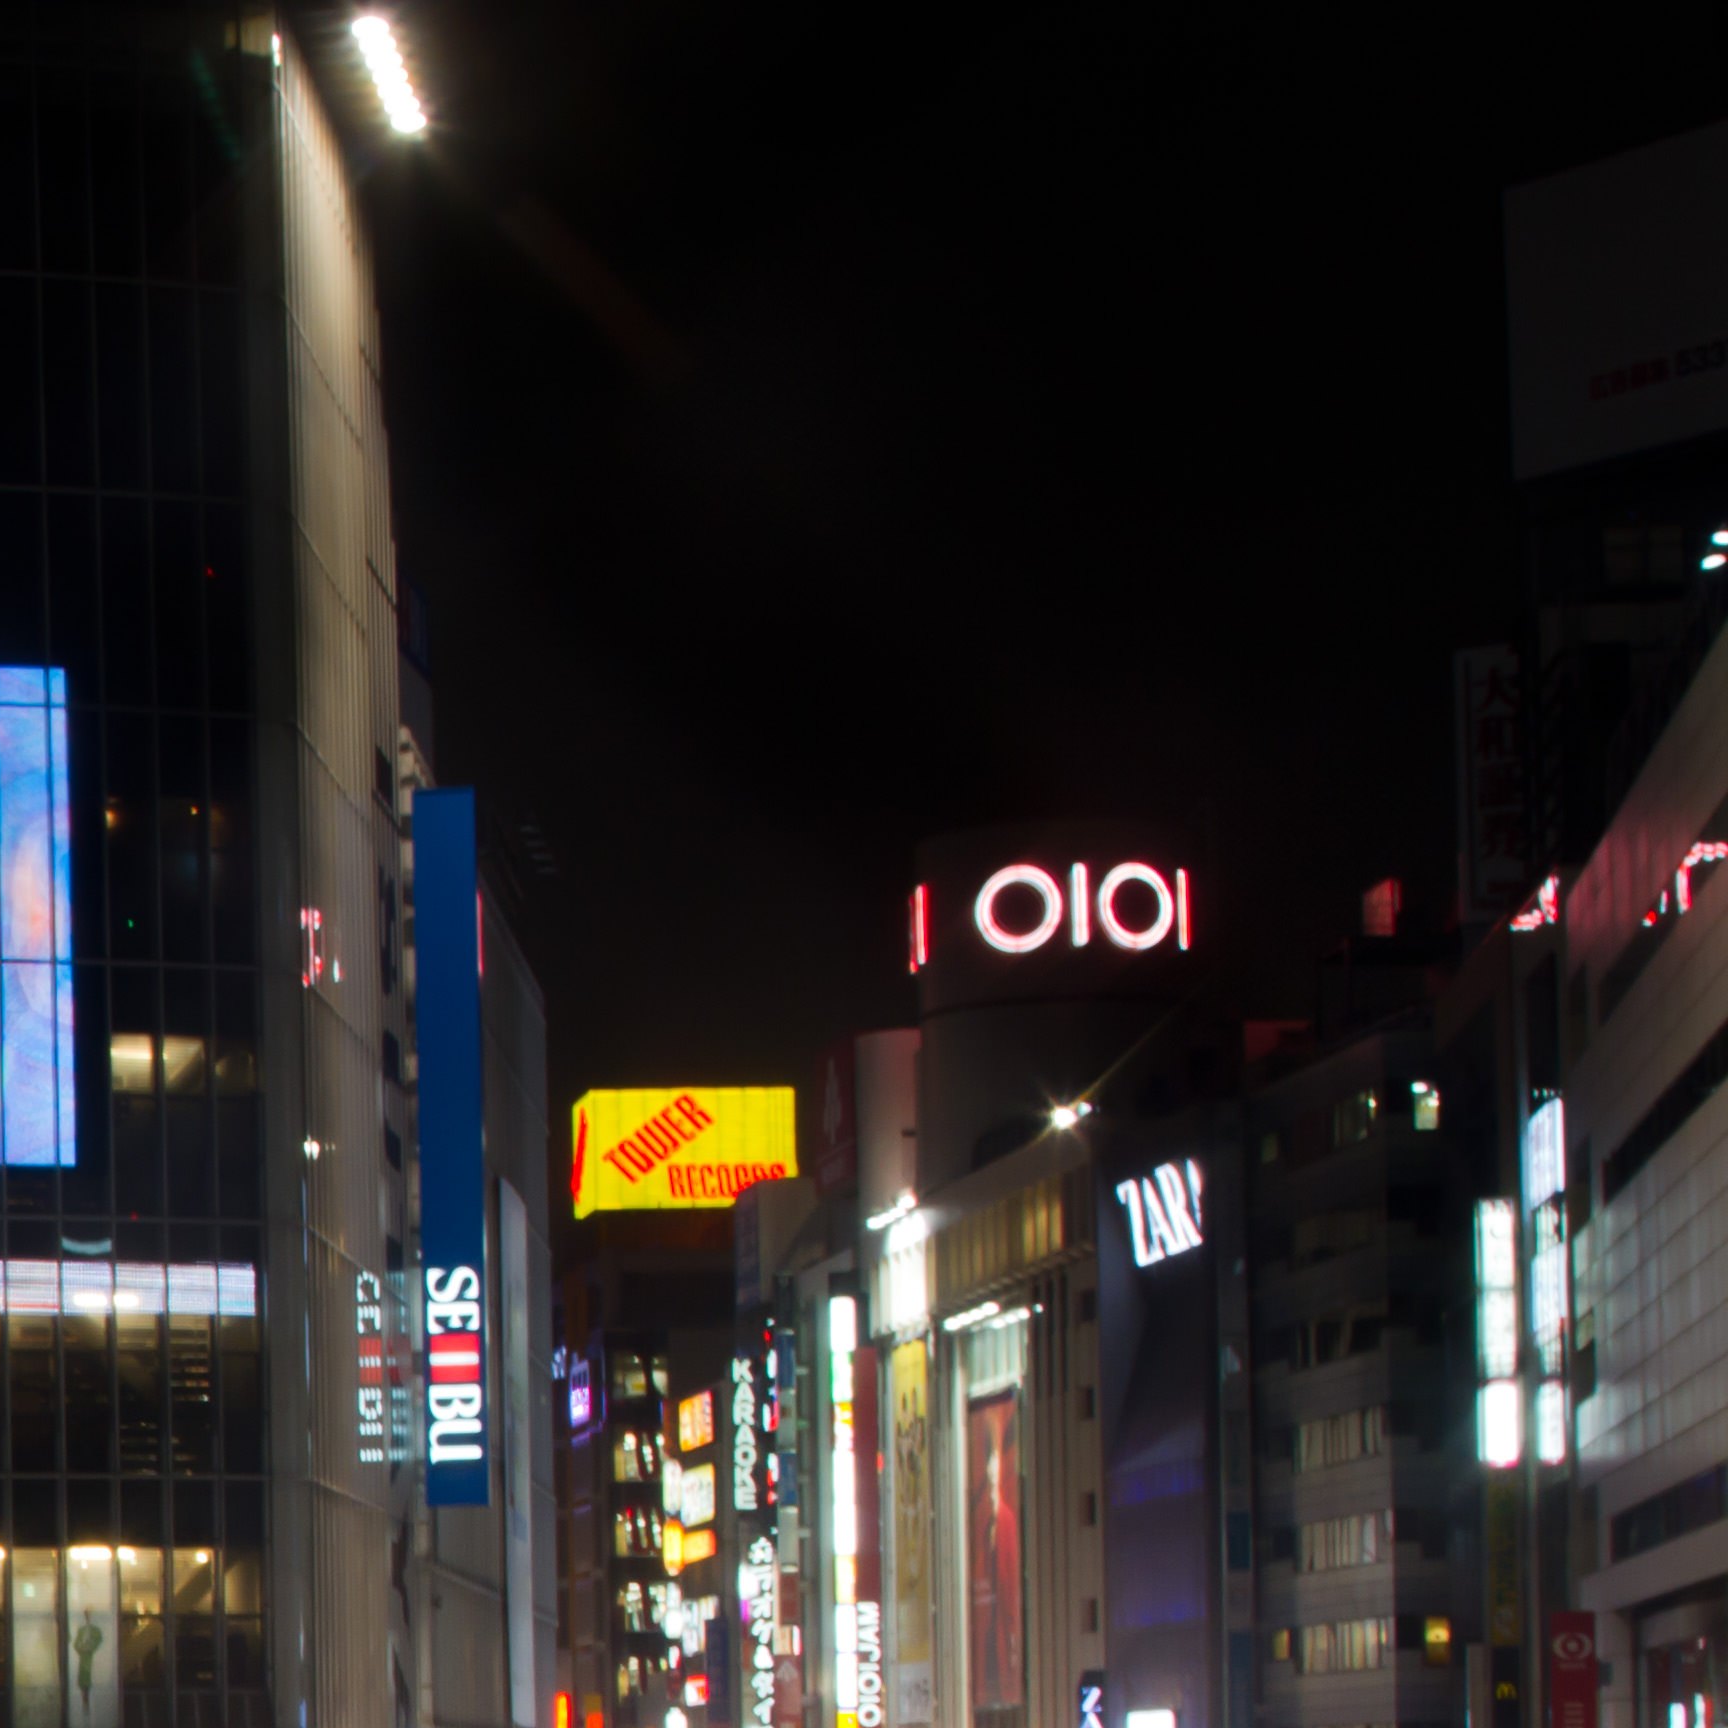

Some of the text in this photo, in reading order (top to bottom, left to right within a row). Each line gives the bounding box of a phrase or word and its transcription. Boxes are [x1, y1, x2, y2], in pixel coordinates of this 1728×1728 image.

[603, 1093, 713, 1184] TOWER
[426, 1265, 482, 1465] SEIBU
[731, 1357, 757, 1511] KARAOKE
